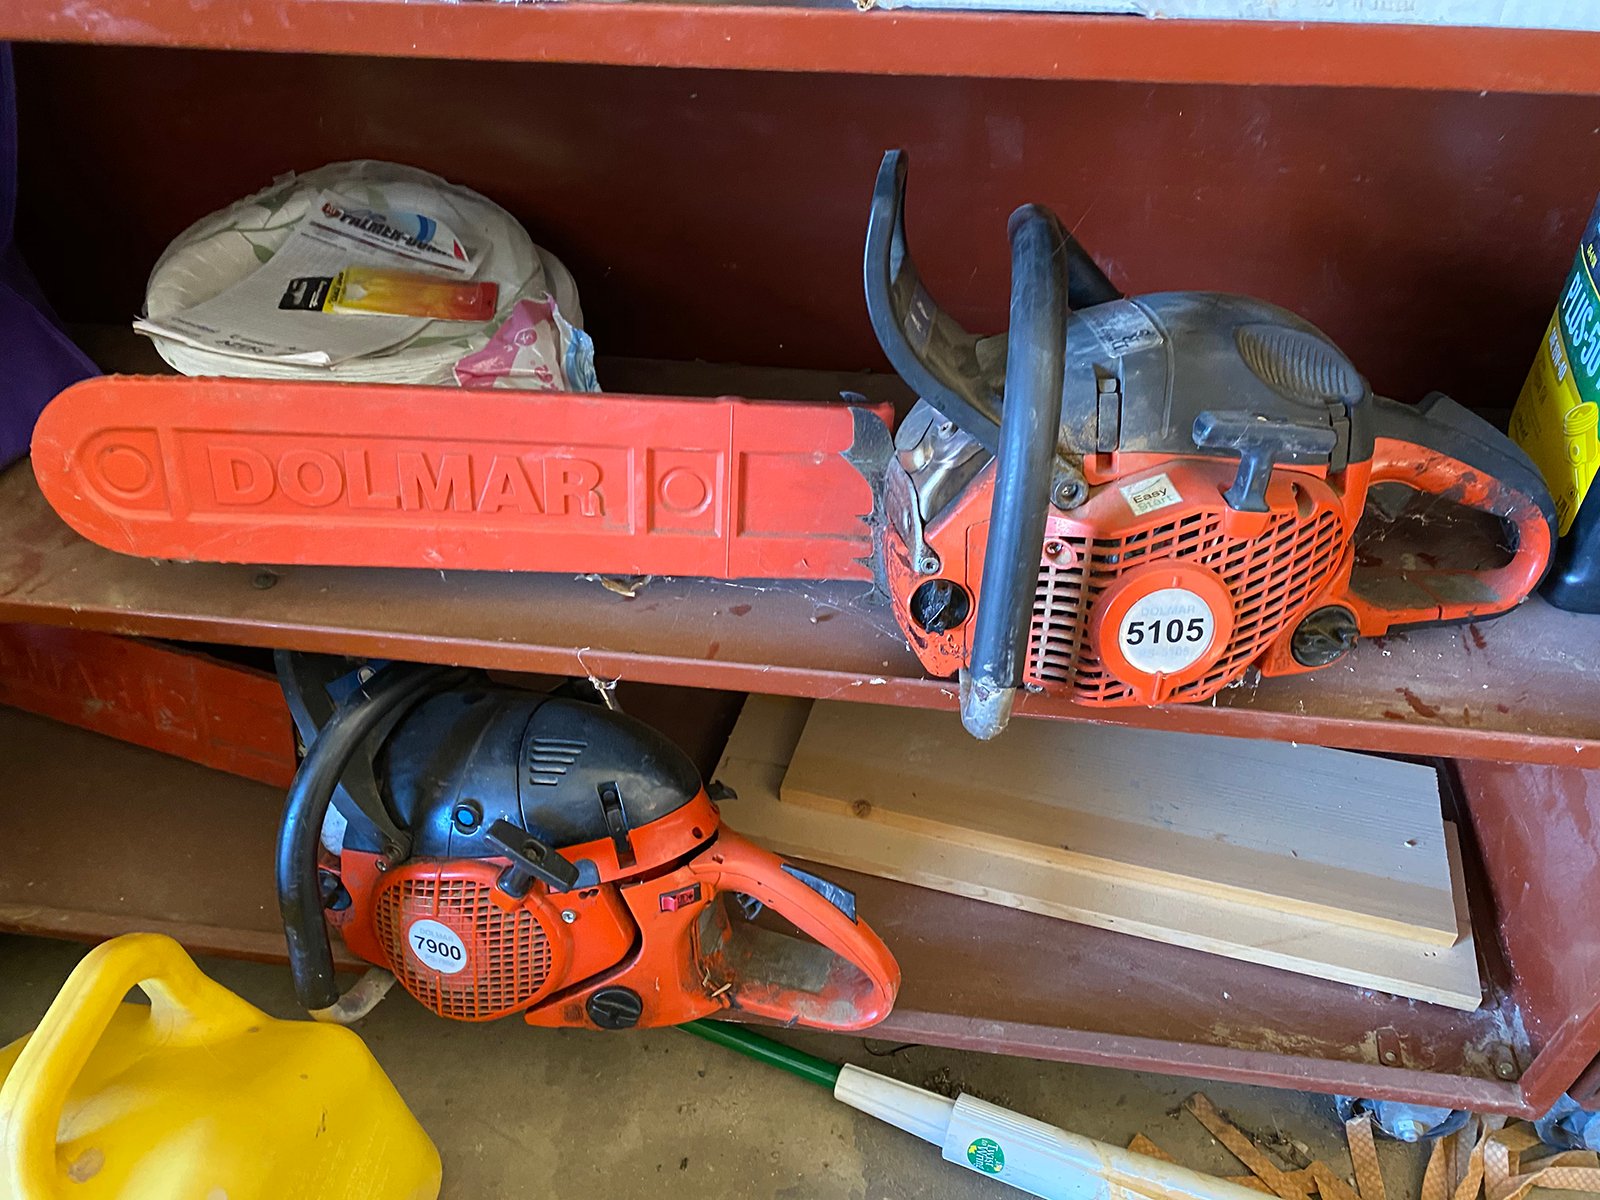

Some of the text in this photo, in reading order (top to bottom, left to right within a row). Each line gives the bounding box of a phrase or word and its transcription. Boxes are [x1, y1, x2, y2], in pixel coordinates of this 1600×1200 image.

[1563, 271, 1600, 376] PLUS-50
[207, 445, 607, 517] DOLMAR
[1133, 487, 1167, 504] Easy
[1126, 618, 1204, 646] 5105
[414, 935, 462, 961] 7900
